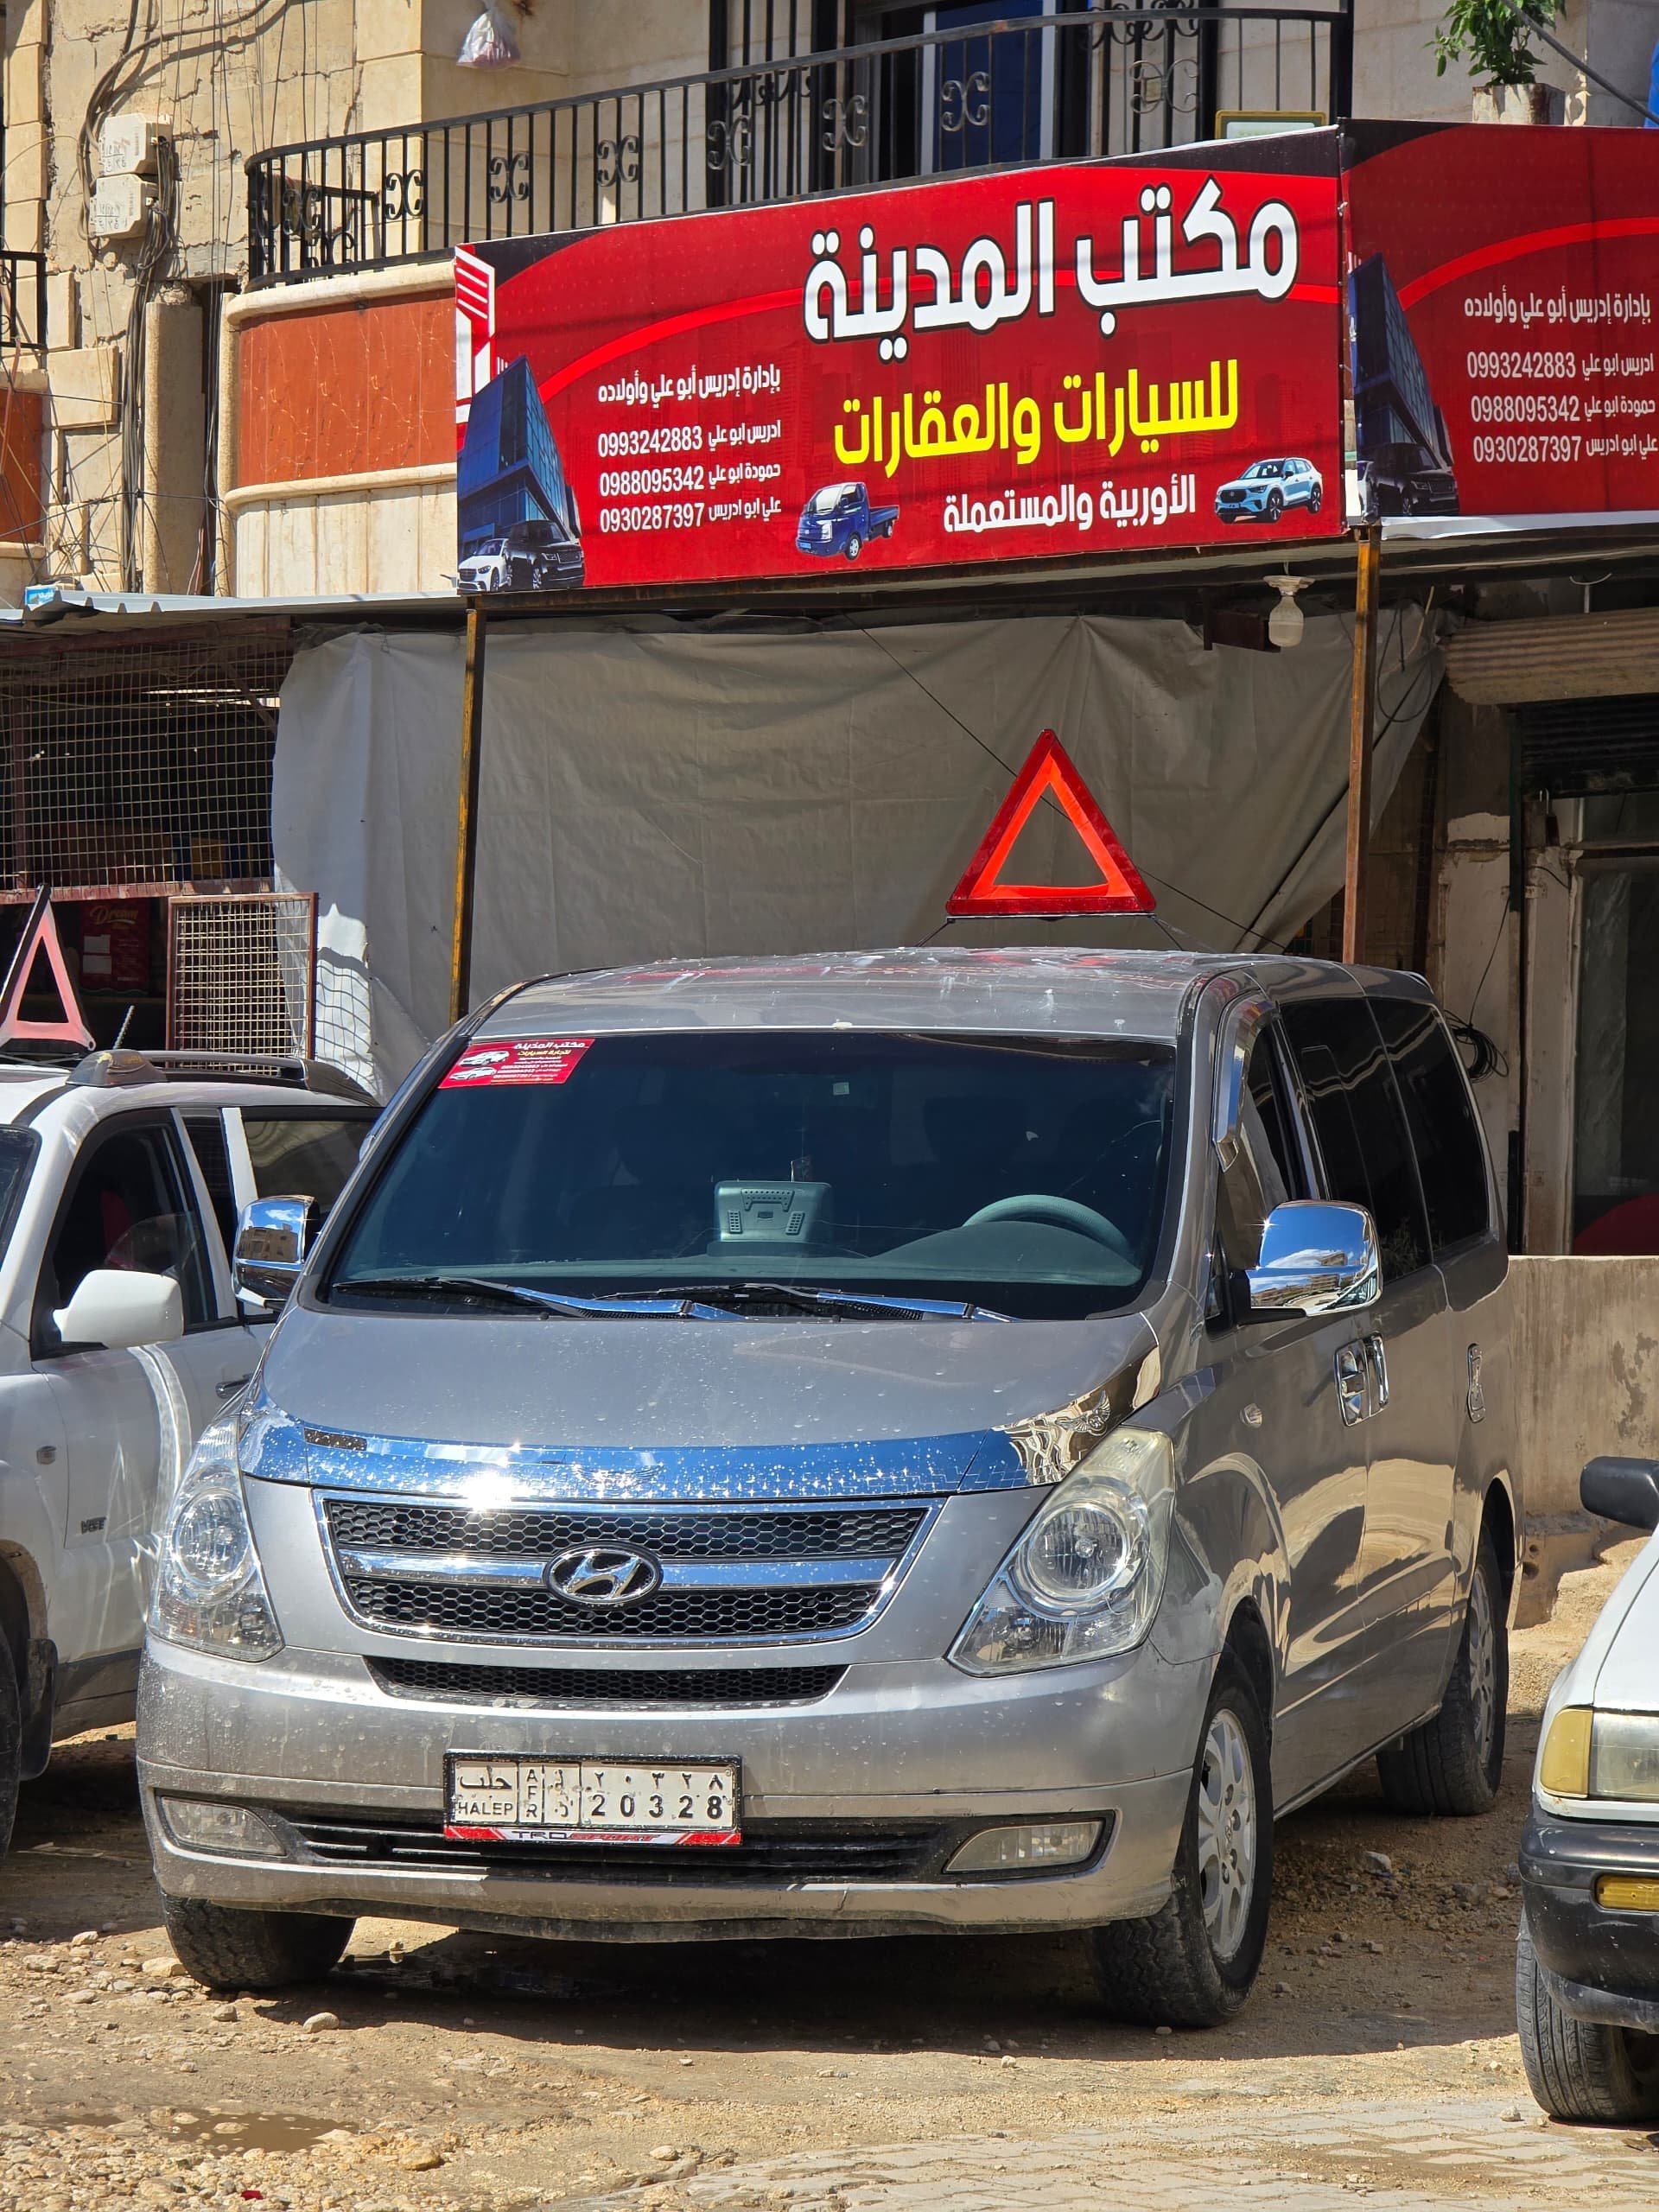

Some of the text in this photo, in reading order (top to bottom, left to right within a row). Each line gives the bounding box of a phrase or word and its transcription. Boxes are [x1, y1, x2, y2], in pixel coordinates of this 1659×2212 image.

[805, 177, 1298, 361] مكتب المدينة
[1465, 284, 1652, 330] بإدارة إدريس أبو علي وأولاده
[1467, 351, 1654, 381] ادريس ابو علي 0993242883
[598, 364, 780, 409] بإدارة إدريس أبو علي وأولاده
[835, 359, 1237, 478] للسيارات والعقارات
[1471, 395, 1656, 423] حمودة ابو علي 0988095342
[598, 419, 781, 457] ادريس ابو علي 0993242883
[1473, 433, 1659, 463] علي ابو ادريس 0930287397
[600, 462, 781, 497] حمودة ابو علي 0988095342
[600, 496, 781, 533] علي ابو ادريس 0930287397
[944, 474, 1196, 532] الأوربية والمستعملة
[459, 1764, 513, 1796] حلب
[594, 1771, 723, 1790] ٢٠٣٢٨
[458, 1802, 513, 1816] HALEP
[591, 1793, 724, 1820] 20328
